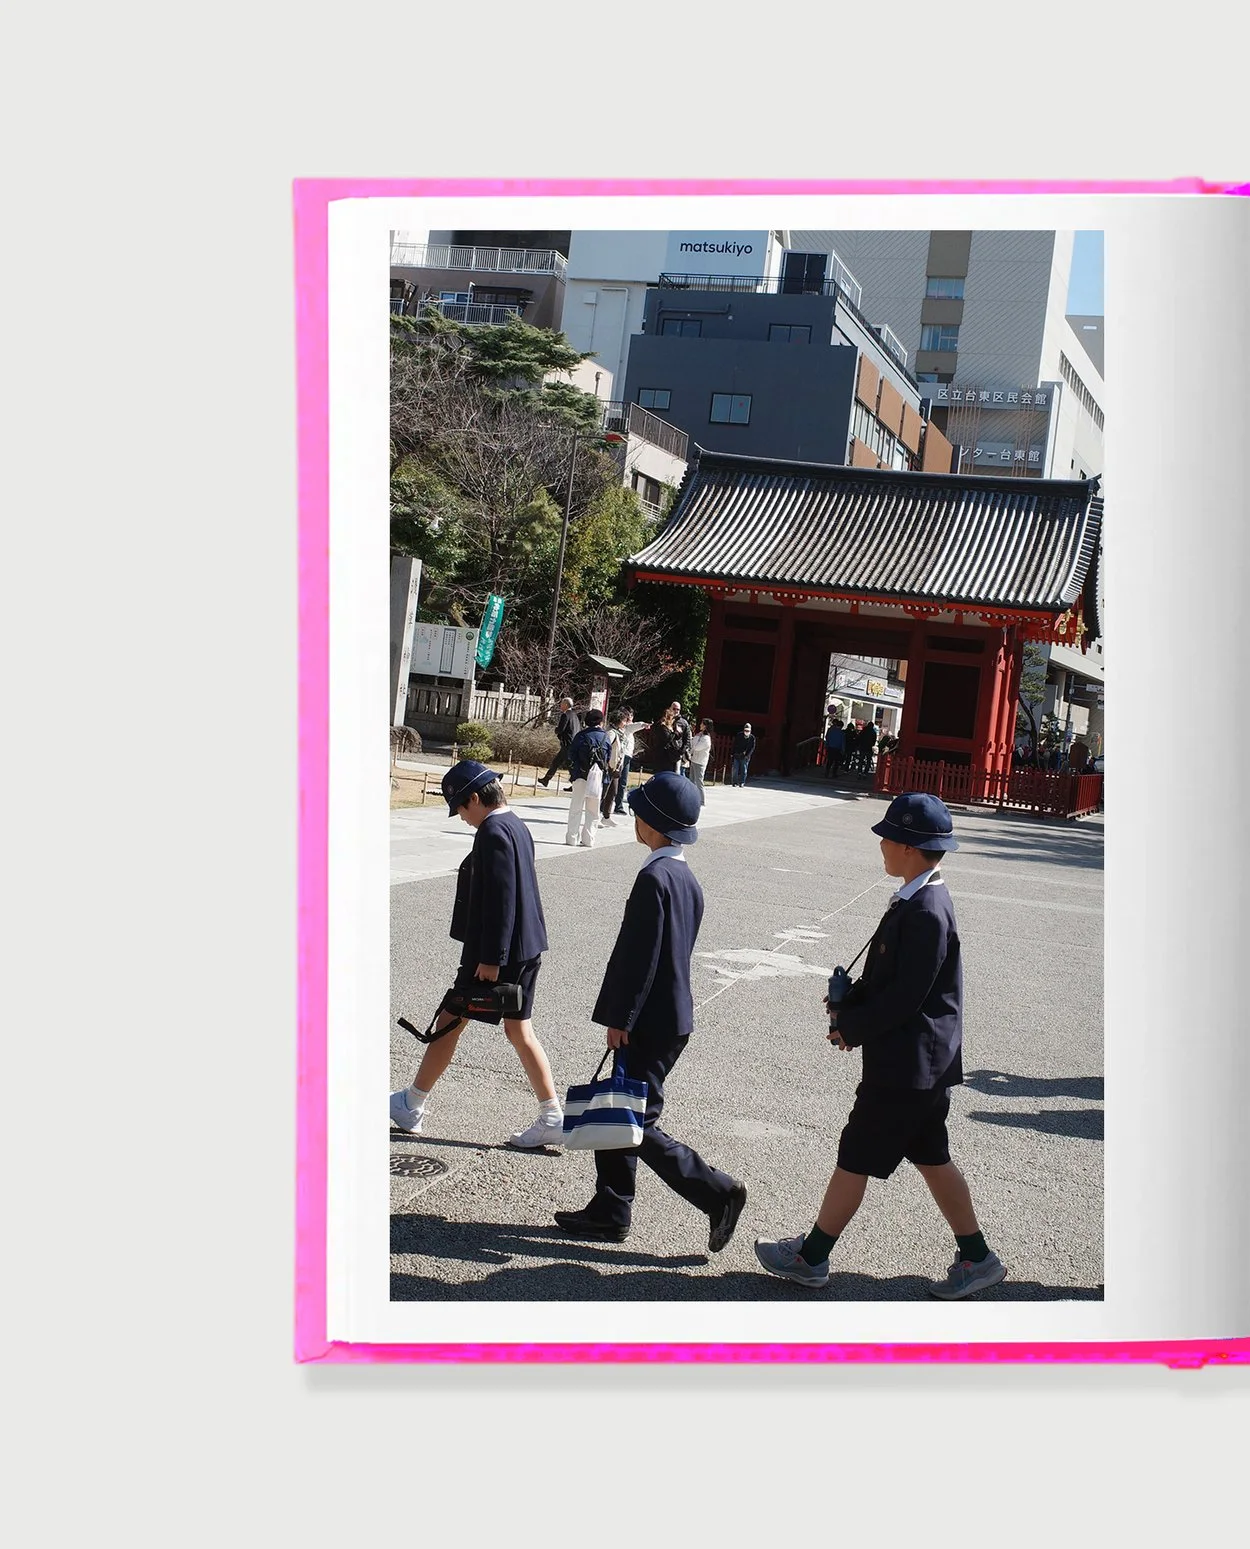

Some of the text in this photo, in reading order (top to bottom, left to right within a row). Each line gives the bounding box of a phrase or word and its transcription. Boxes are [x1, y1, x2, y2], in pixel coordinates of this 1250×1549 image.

[680, 241, 753, 257] matsukiyo
[938, 388, 1046, 404] 区立台東区民会館
